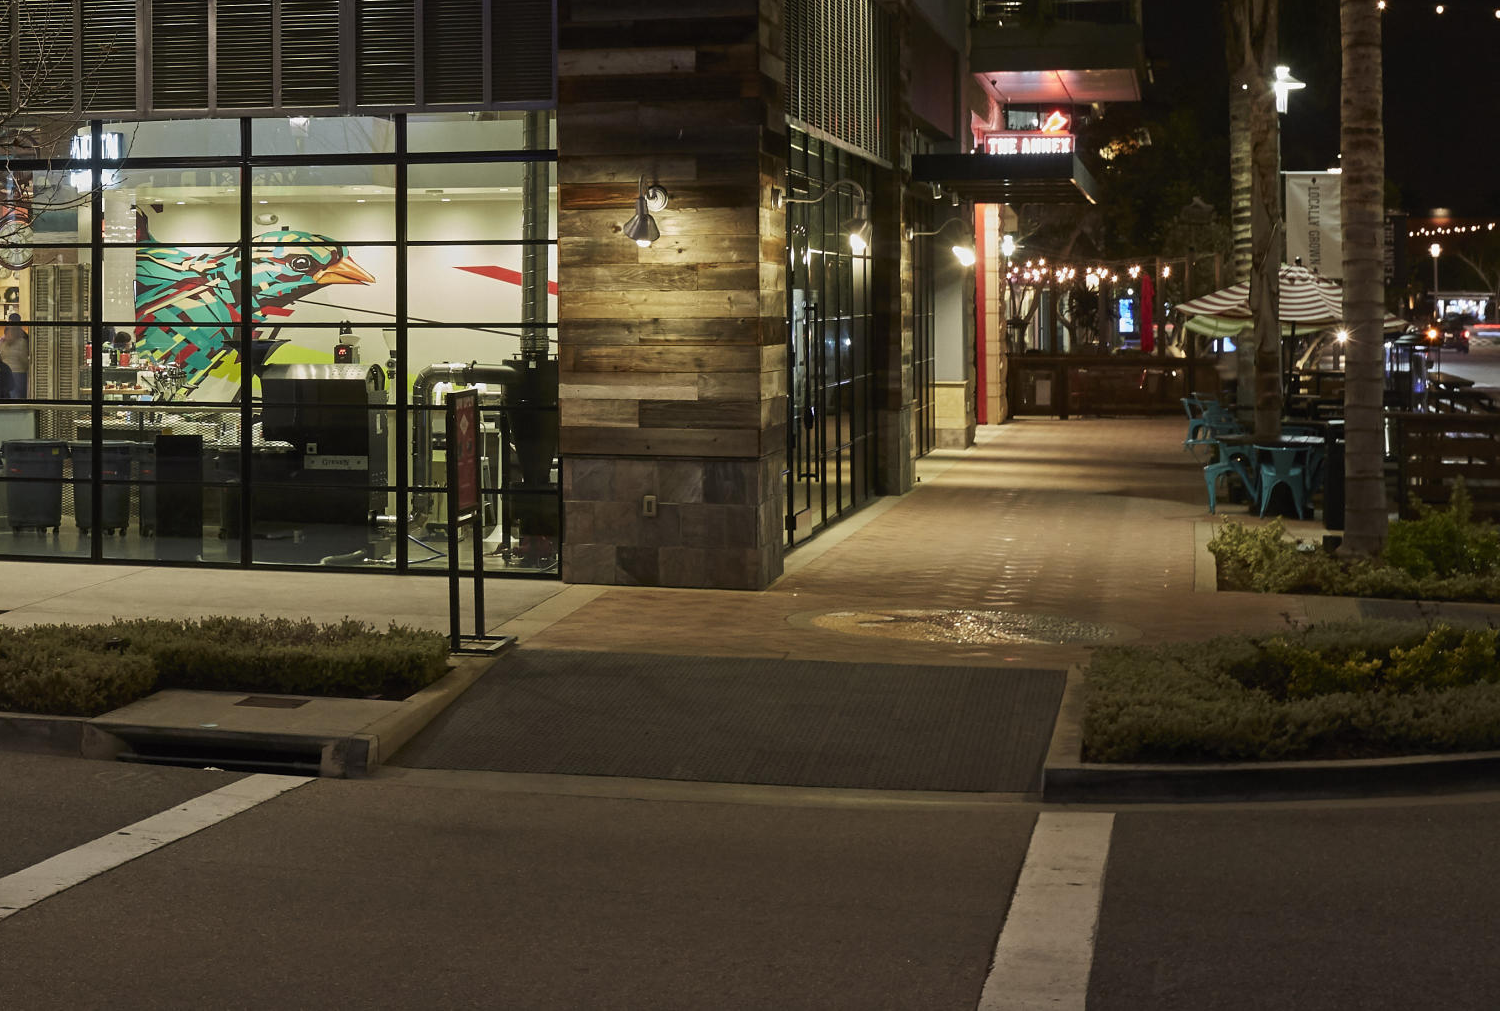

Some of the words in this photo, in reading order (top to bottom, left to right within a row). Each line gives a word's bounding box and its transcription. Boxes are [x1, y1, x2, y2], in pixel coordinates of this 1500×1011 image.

[987, 137, 1018, 155] THE
[1308, 186, 1321, 227] LOCALLY
[1308, 229, 1321, 265] GROWN
